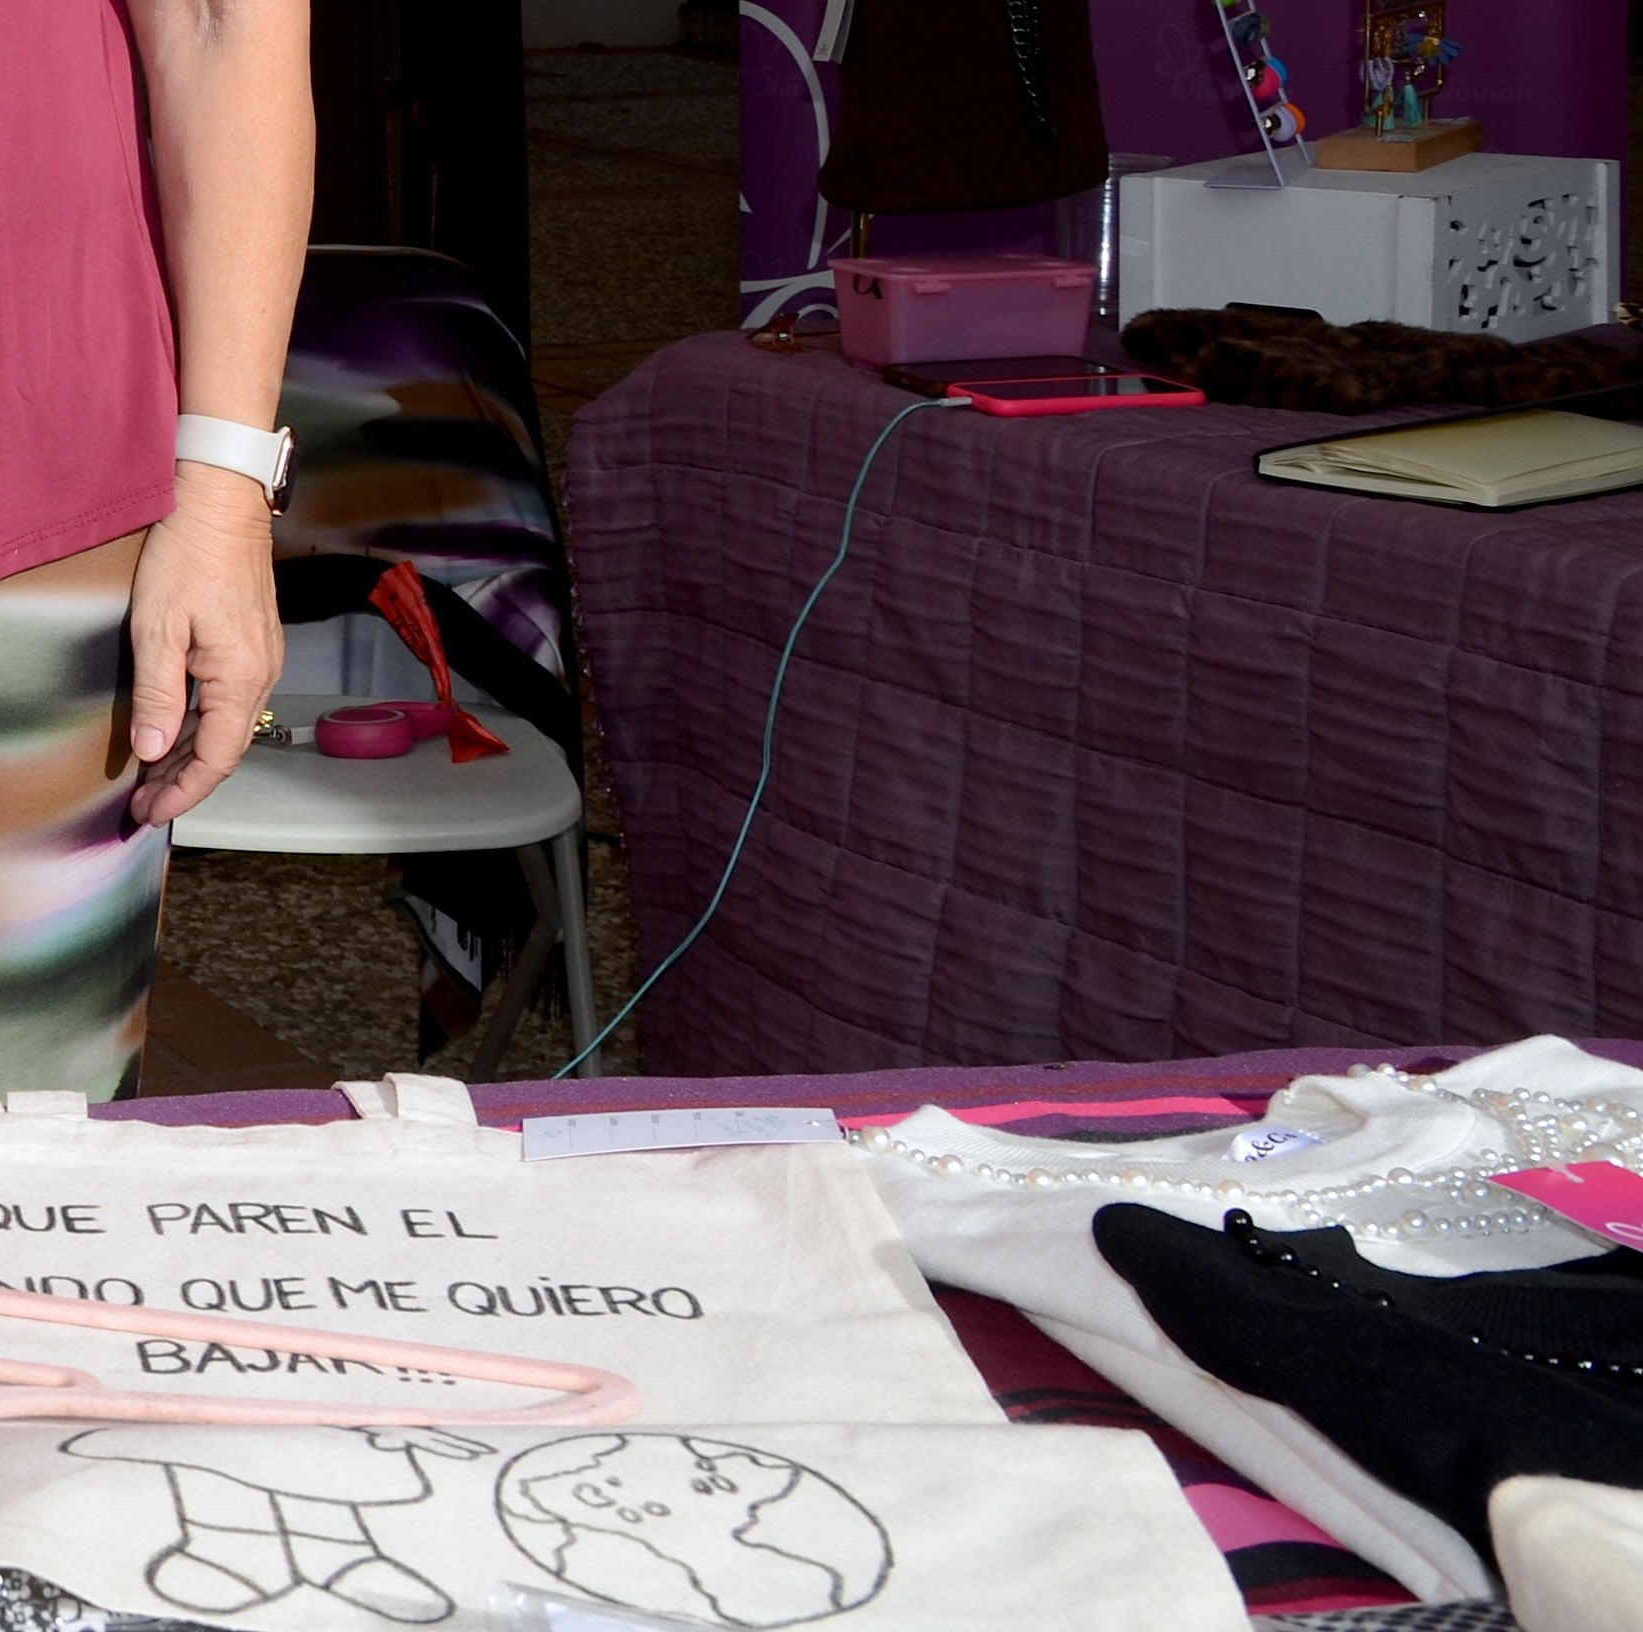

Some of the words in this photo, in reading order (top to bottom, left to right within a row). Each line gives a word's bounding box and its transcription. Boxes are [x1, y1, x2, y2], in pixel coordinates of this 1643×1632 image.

[146, 1201, 368, 1236] PAREN
[400, 1207, 499, 1240] EL
[180, 1277, 318, 1312] QUE
[327, 1276, 428, 1313] ME
